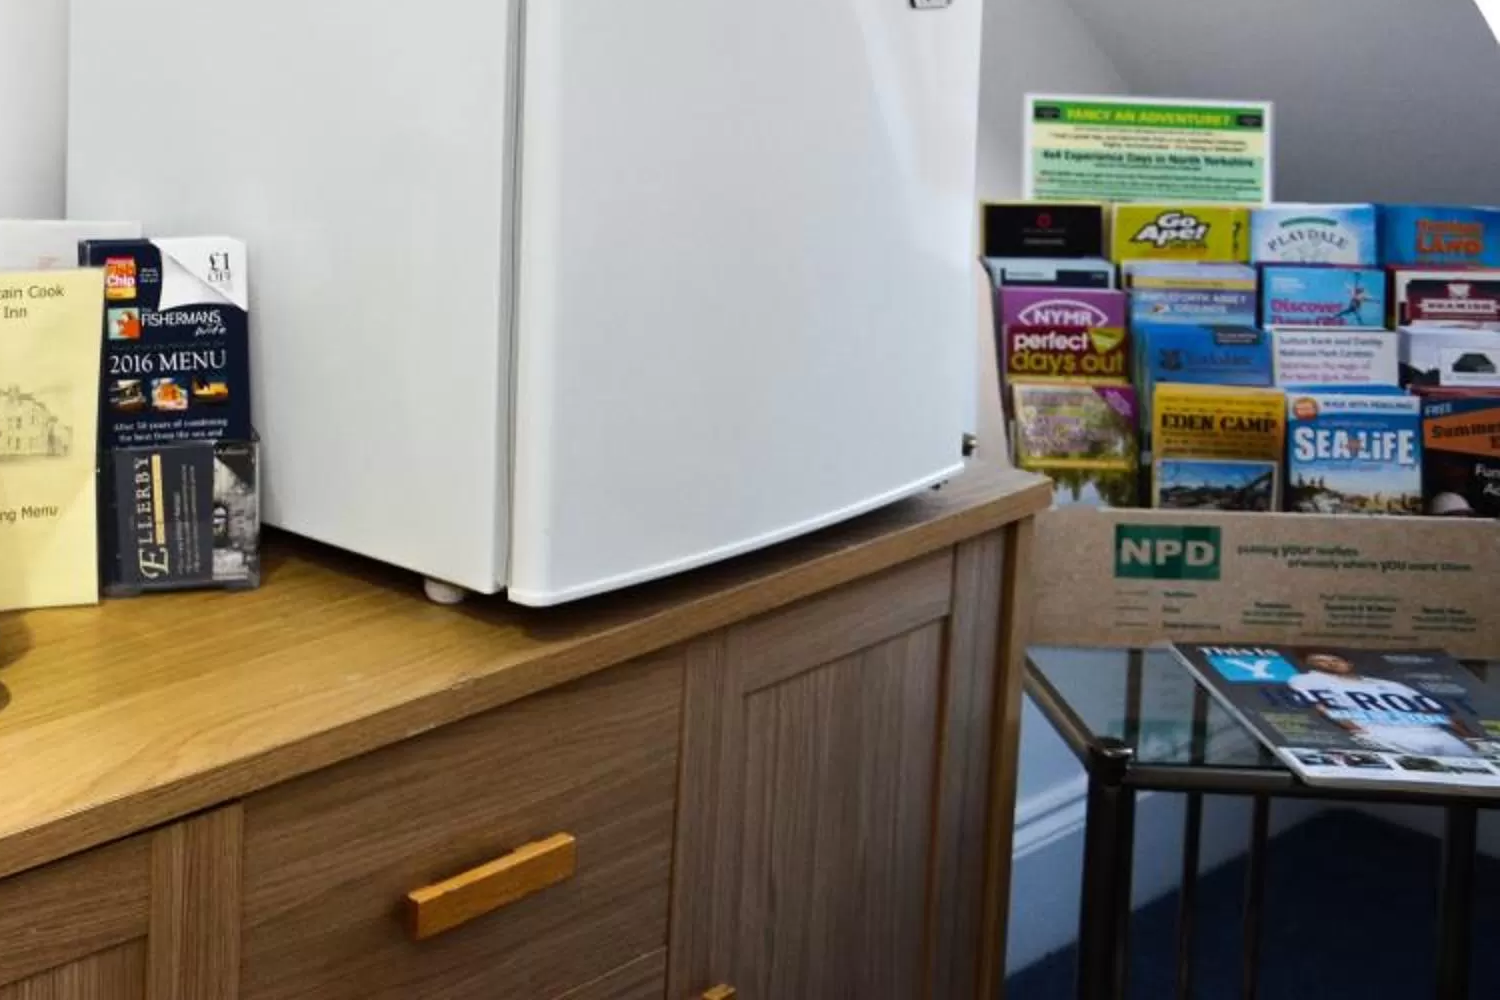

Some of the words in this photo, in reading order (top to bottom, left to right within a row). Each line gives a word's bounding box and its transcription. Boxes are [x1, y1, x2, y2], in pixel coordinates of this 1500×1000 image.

[1064, 150, 1124, 162] Experience
[1204, 156, 1254, 168] Yorkshire
[1157, 211, 1198, 229] Go
[1135, 221, 1208, 246] Ape!
[1267, 228, 1349, 252] PLAYDALE
[208, 252, 230, 273] £1
[107, 274, 136, 288] Chip
[30, 284, 65, 299] Cook
[3, 307, 27, 319] Inn
[1032, 309, 1093, 325] NYMR
[1014, 331, 1088, 353] perfect
[109, 354, 153, 374] 2016
[159, 349, 227, 371] MENU
[1011, 351, 1076, 378] days
[1080, 350, 1124, 373] out
[1161, 413, 1214, 430] EDEN
[1219, 414, 1277, 433] CAMP
[1293, 427, 1350, 461] SEA
[21, 505, 59, 519] Menu
[133, 456, 170, 579] ELLERBY
[1119, 537, 1217, 566] NPD
[1380, 560, 1407, 573] you
